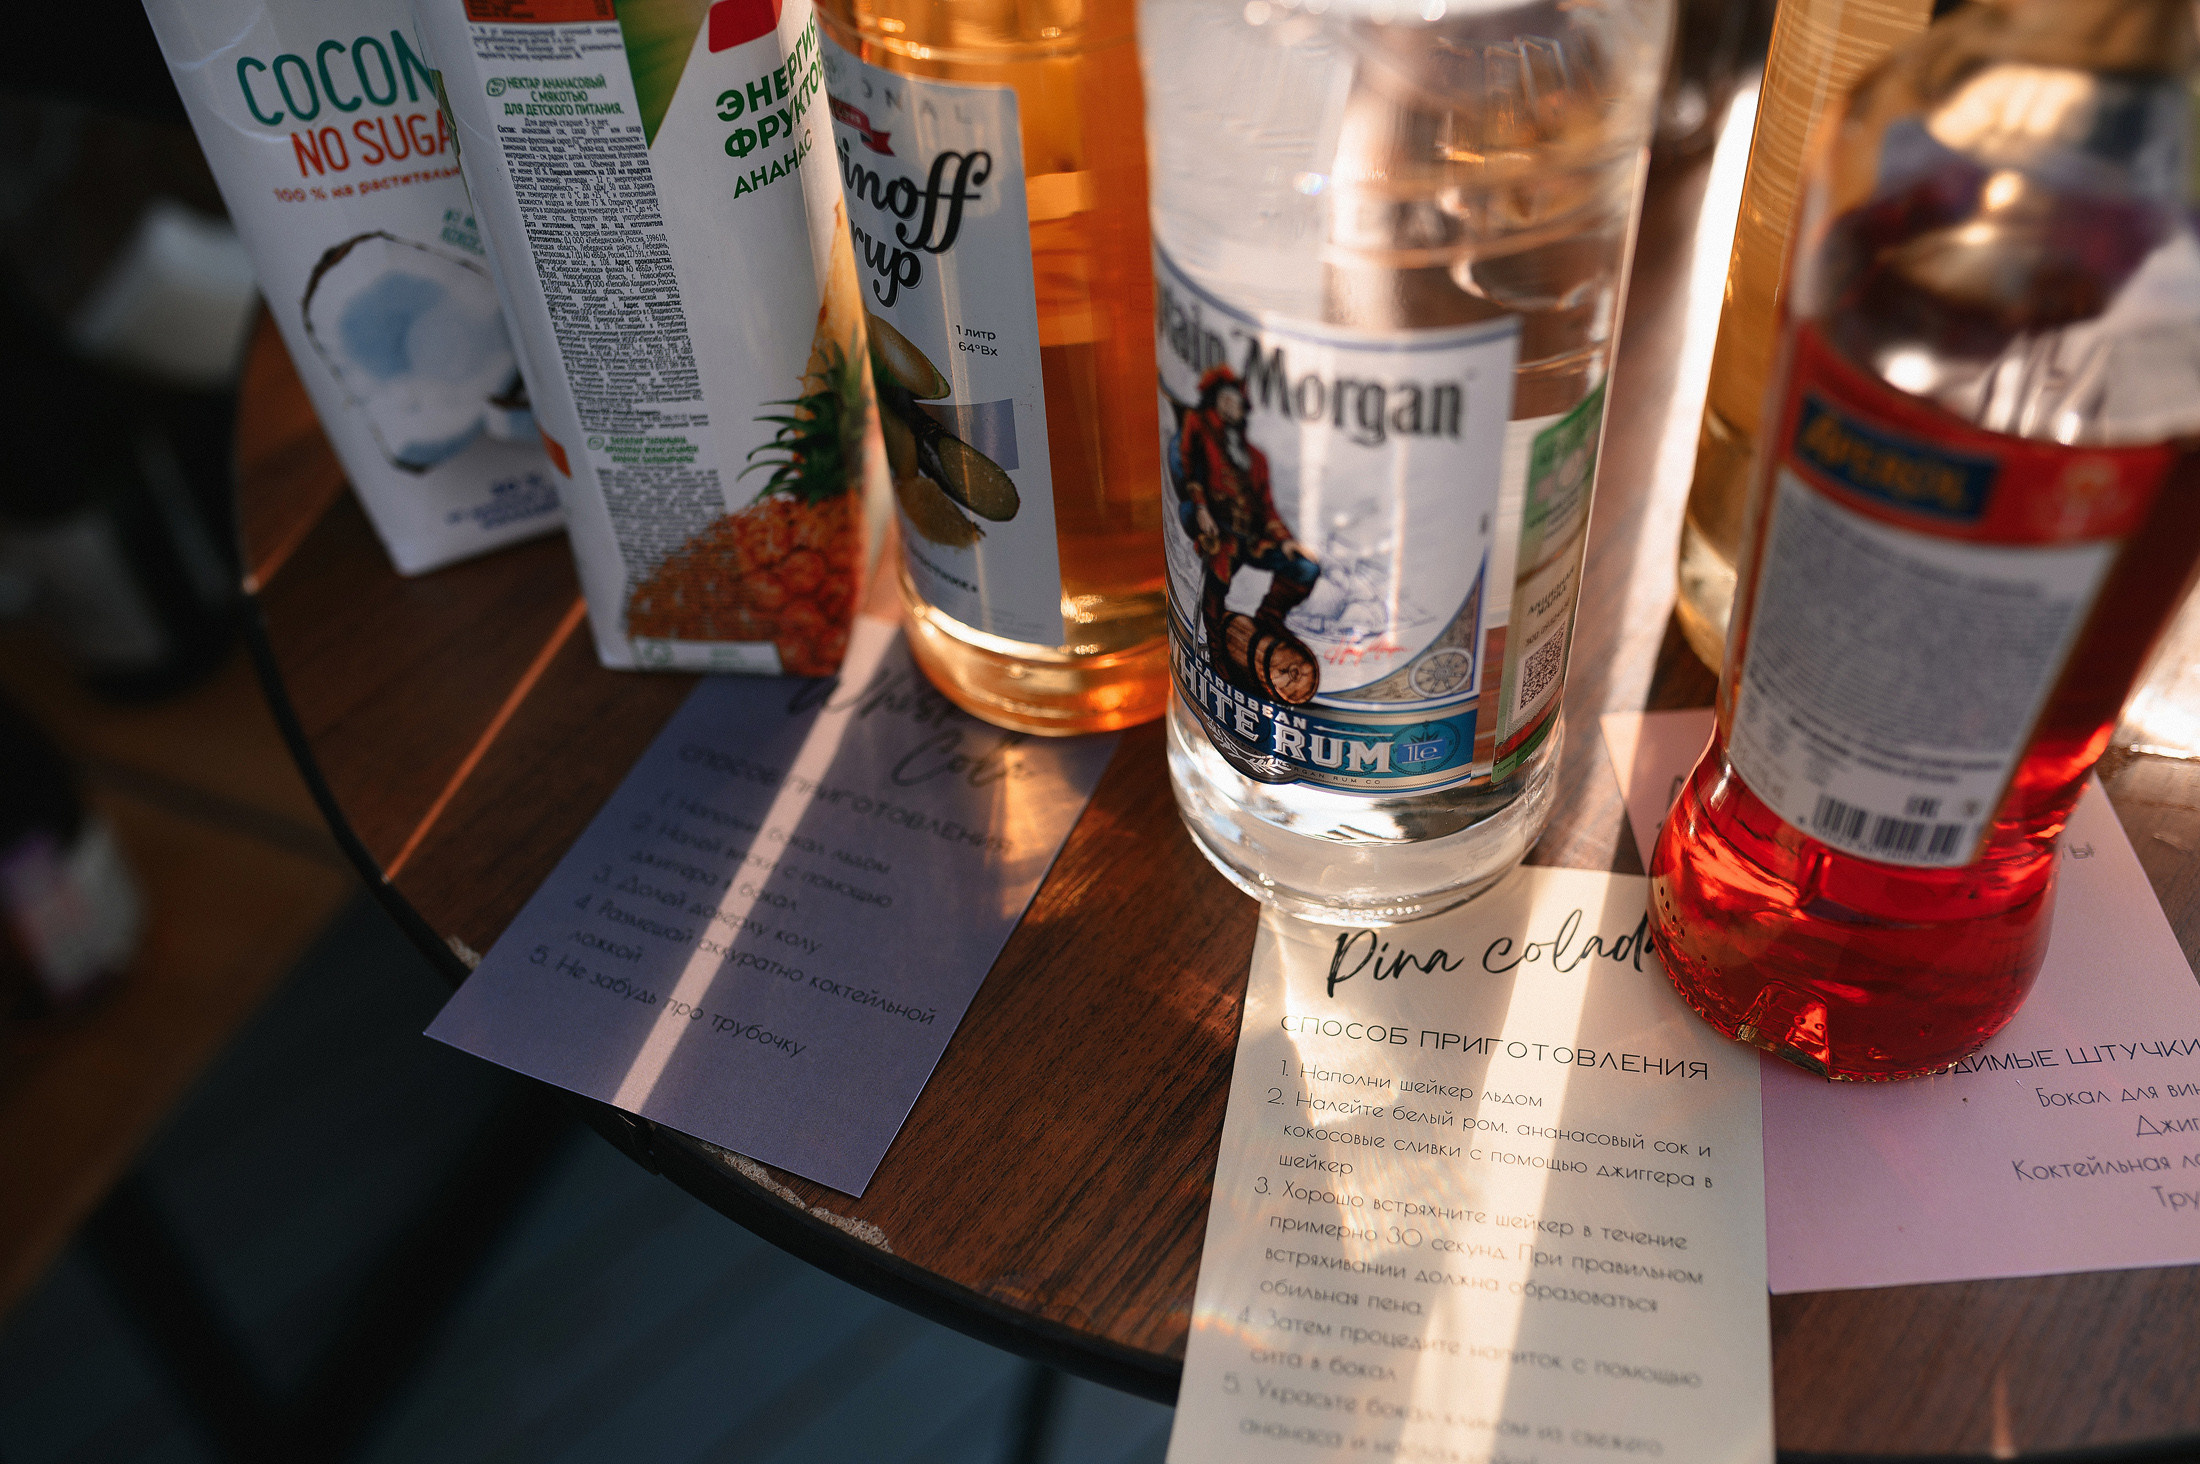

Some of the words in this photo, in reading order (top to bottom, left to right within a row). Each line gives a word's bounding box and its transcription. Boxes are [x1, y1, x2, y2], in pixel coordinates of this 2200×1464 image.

[506, 77, 540, 89] НЕКТАР
[542, 74, 607, 89] АНАНАСОВЫЙ
[539, 90, 589, 102] МЯКОТЬЮ
[504, 103, 525, 116] ДЛЯ
[526, 104, 574, 117] ДЕТСКОГО
[576, 102, 625, 115] ПИТАНИЯ.
[290, 126, 350, 178] NO
[733, 129, 812, 200] АНАНАС
[273, 188, 307, 203] 100
[310, 186, 328, 201] %
[956, 325, 962, 336] 1
[964, 327, 996, 341] литр
[1234, 329, 1465, 447] Morgan
[1195, 657, 1308, 730] CARIBBEAN
[1273, 721, 1395, 774] RUM
[1293, 767, 1325, 779] RGAN
[1333, 776, 1357, 784] RUM
[598, 899, 694, 945] Размешай
[697, 937, 805, 982] аккуратно
[809, 972, 936, 1027] коктейльной
[775, 930, 824, 955] колу
[1328, 928, 1464, 998] Pina
[557, 955, 587, 981] Не
[590, 973, 658, 1007] забудь
[664, 997, 705, 1022] про
[711, 1012, 807, 1058] трубочку
[1281, 1015, 1409, 1046] СПОСОБ
[1419, 1030, 1709, 1081] ПРИГОТОВЛЕНИЯ
[1281, 1060, 1290, 1078] 1.
[1299, 1063, 1391, 1090] Наполни
[1399, 1075, 1474, 1102] шейкер
[1482, 1090, 1543, 1109] льдом
[2035, 1087, 2111, 1108] Бокал
[2121, 1086, 2159, 1102] для
[1267, 1087, 1286, 1106] 2.
[1296, 1092, 1385, 1118] Налейте
[1393, 1104, 1453, 1127] белый
[1463, 1116, 1508, 1137] ром.
[1517, 1124, 1645, 1151] ананасовый
[1654, 1139, 1691, 1156] сок
[1699, 1144, 1712, 1157] и
[1279, 1151, 1354, 1176] шейкер
[1283, 1124, 1386, 1150] кокосовые
[1393, 1138, 1461, 1158] сливки
[1470, 1148, 1482, 1160] с
[1490, 1150, 1588, 1175] помощью
[1596, 1164, 1696, 1189] джиггера
[1704, 1176, 1714, 1189] в
[2012, 1155, 2172, 1181] Коктейльная
[1254, 1176, 1272, 1195] 3.
[1282, 1180, 1364, 1208] Хорошо
[1374, 1198, 1487, 1225] встряхните
[1496, 1214, 1574, 1239] шейкер
[1583, 1225, 1593, 1238] в
[1601, 1227, 1689, 1250] течение
[1269, 1215, 1378, 1242] примерно
[1386, 1226, 1423, 1249] 30
[1518, 1243, 1563, 1268] При
[1571, 1256, 1704, 1285] правильном
[1259, 1278, 1359, 1307] обильная
[1265, 1247, 1407, 1279] встряхивании
[1414, 1269, 1500, 1292] должна
[1508, 1278, 1659, 1313] образоваться
[1267, 1308, 1332, 1337] Затем
[1340, 1325, 1461, 1355] процедите
[1469, 1343, 1563, 1371] напиток
